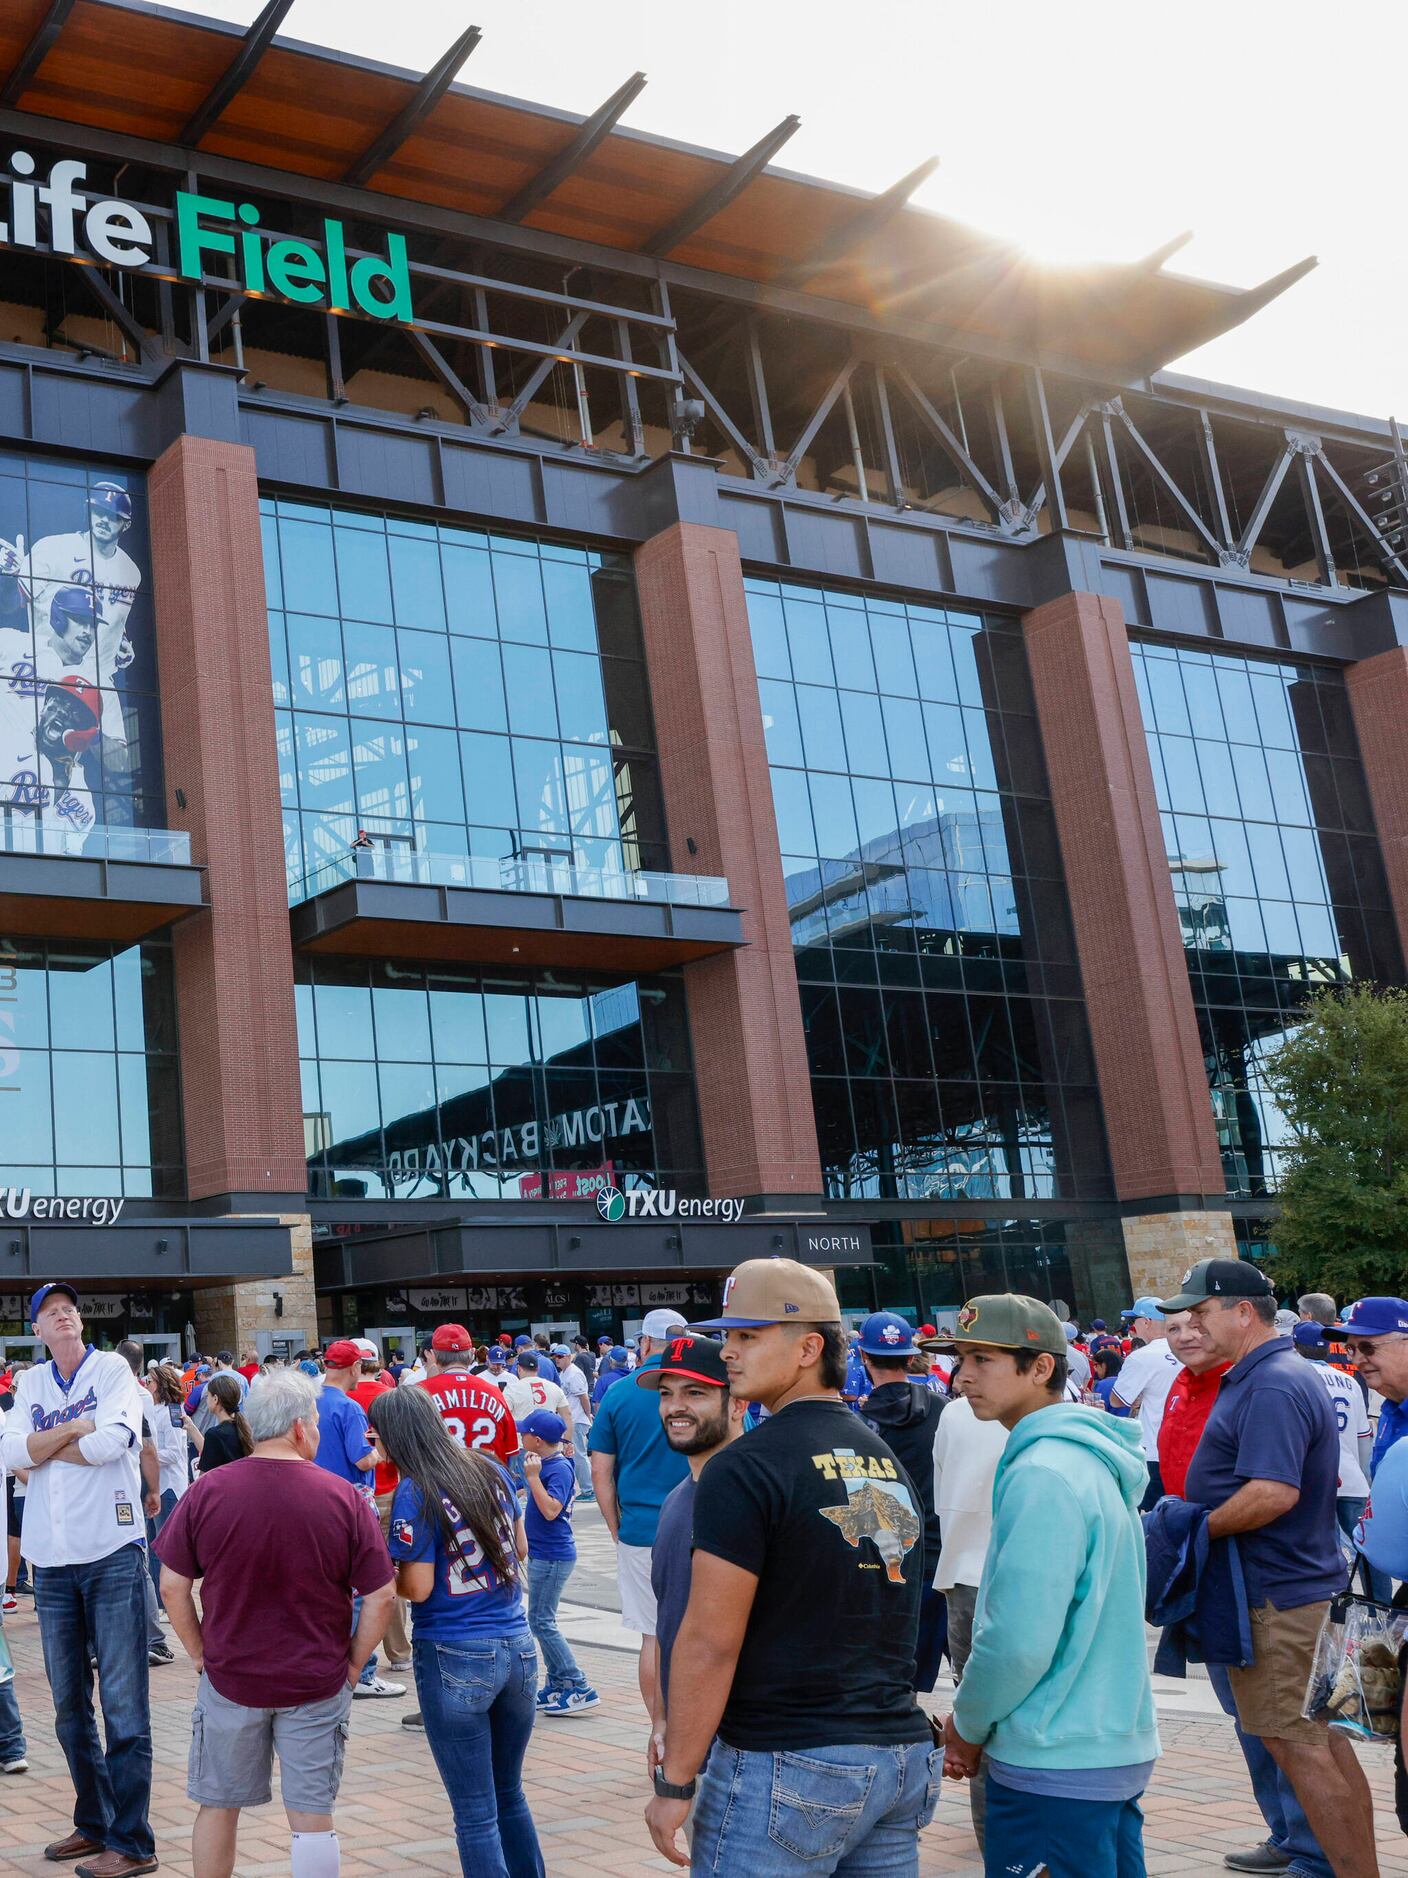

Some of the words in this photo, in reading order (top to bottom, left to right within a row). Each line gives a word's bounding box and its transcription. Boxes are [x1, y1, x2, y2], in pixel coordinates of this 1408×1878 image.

[175, 190, 414, 324] Field
[33, 1196, 125, 1225] energy
[625, 1189, 677, 1217] TXU
[679, 1196, 745, 1221] energy
[808, 1237, 861, 1251] NORTH
[669, 1337, 695, 1362] T
[530, 1382, 547, 1405] 5
[1322, 1373, 1353, 1390] UNG
[432, 1388, 506, 1423] AMILTON
[811, 1453, 898, 1480] TEXAS
